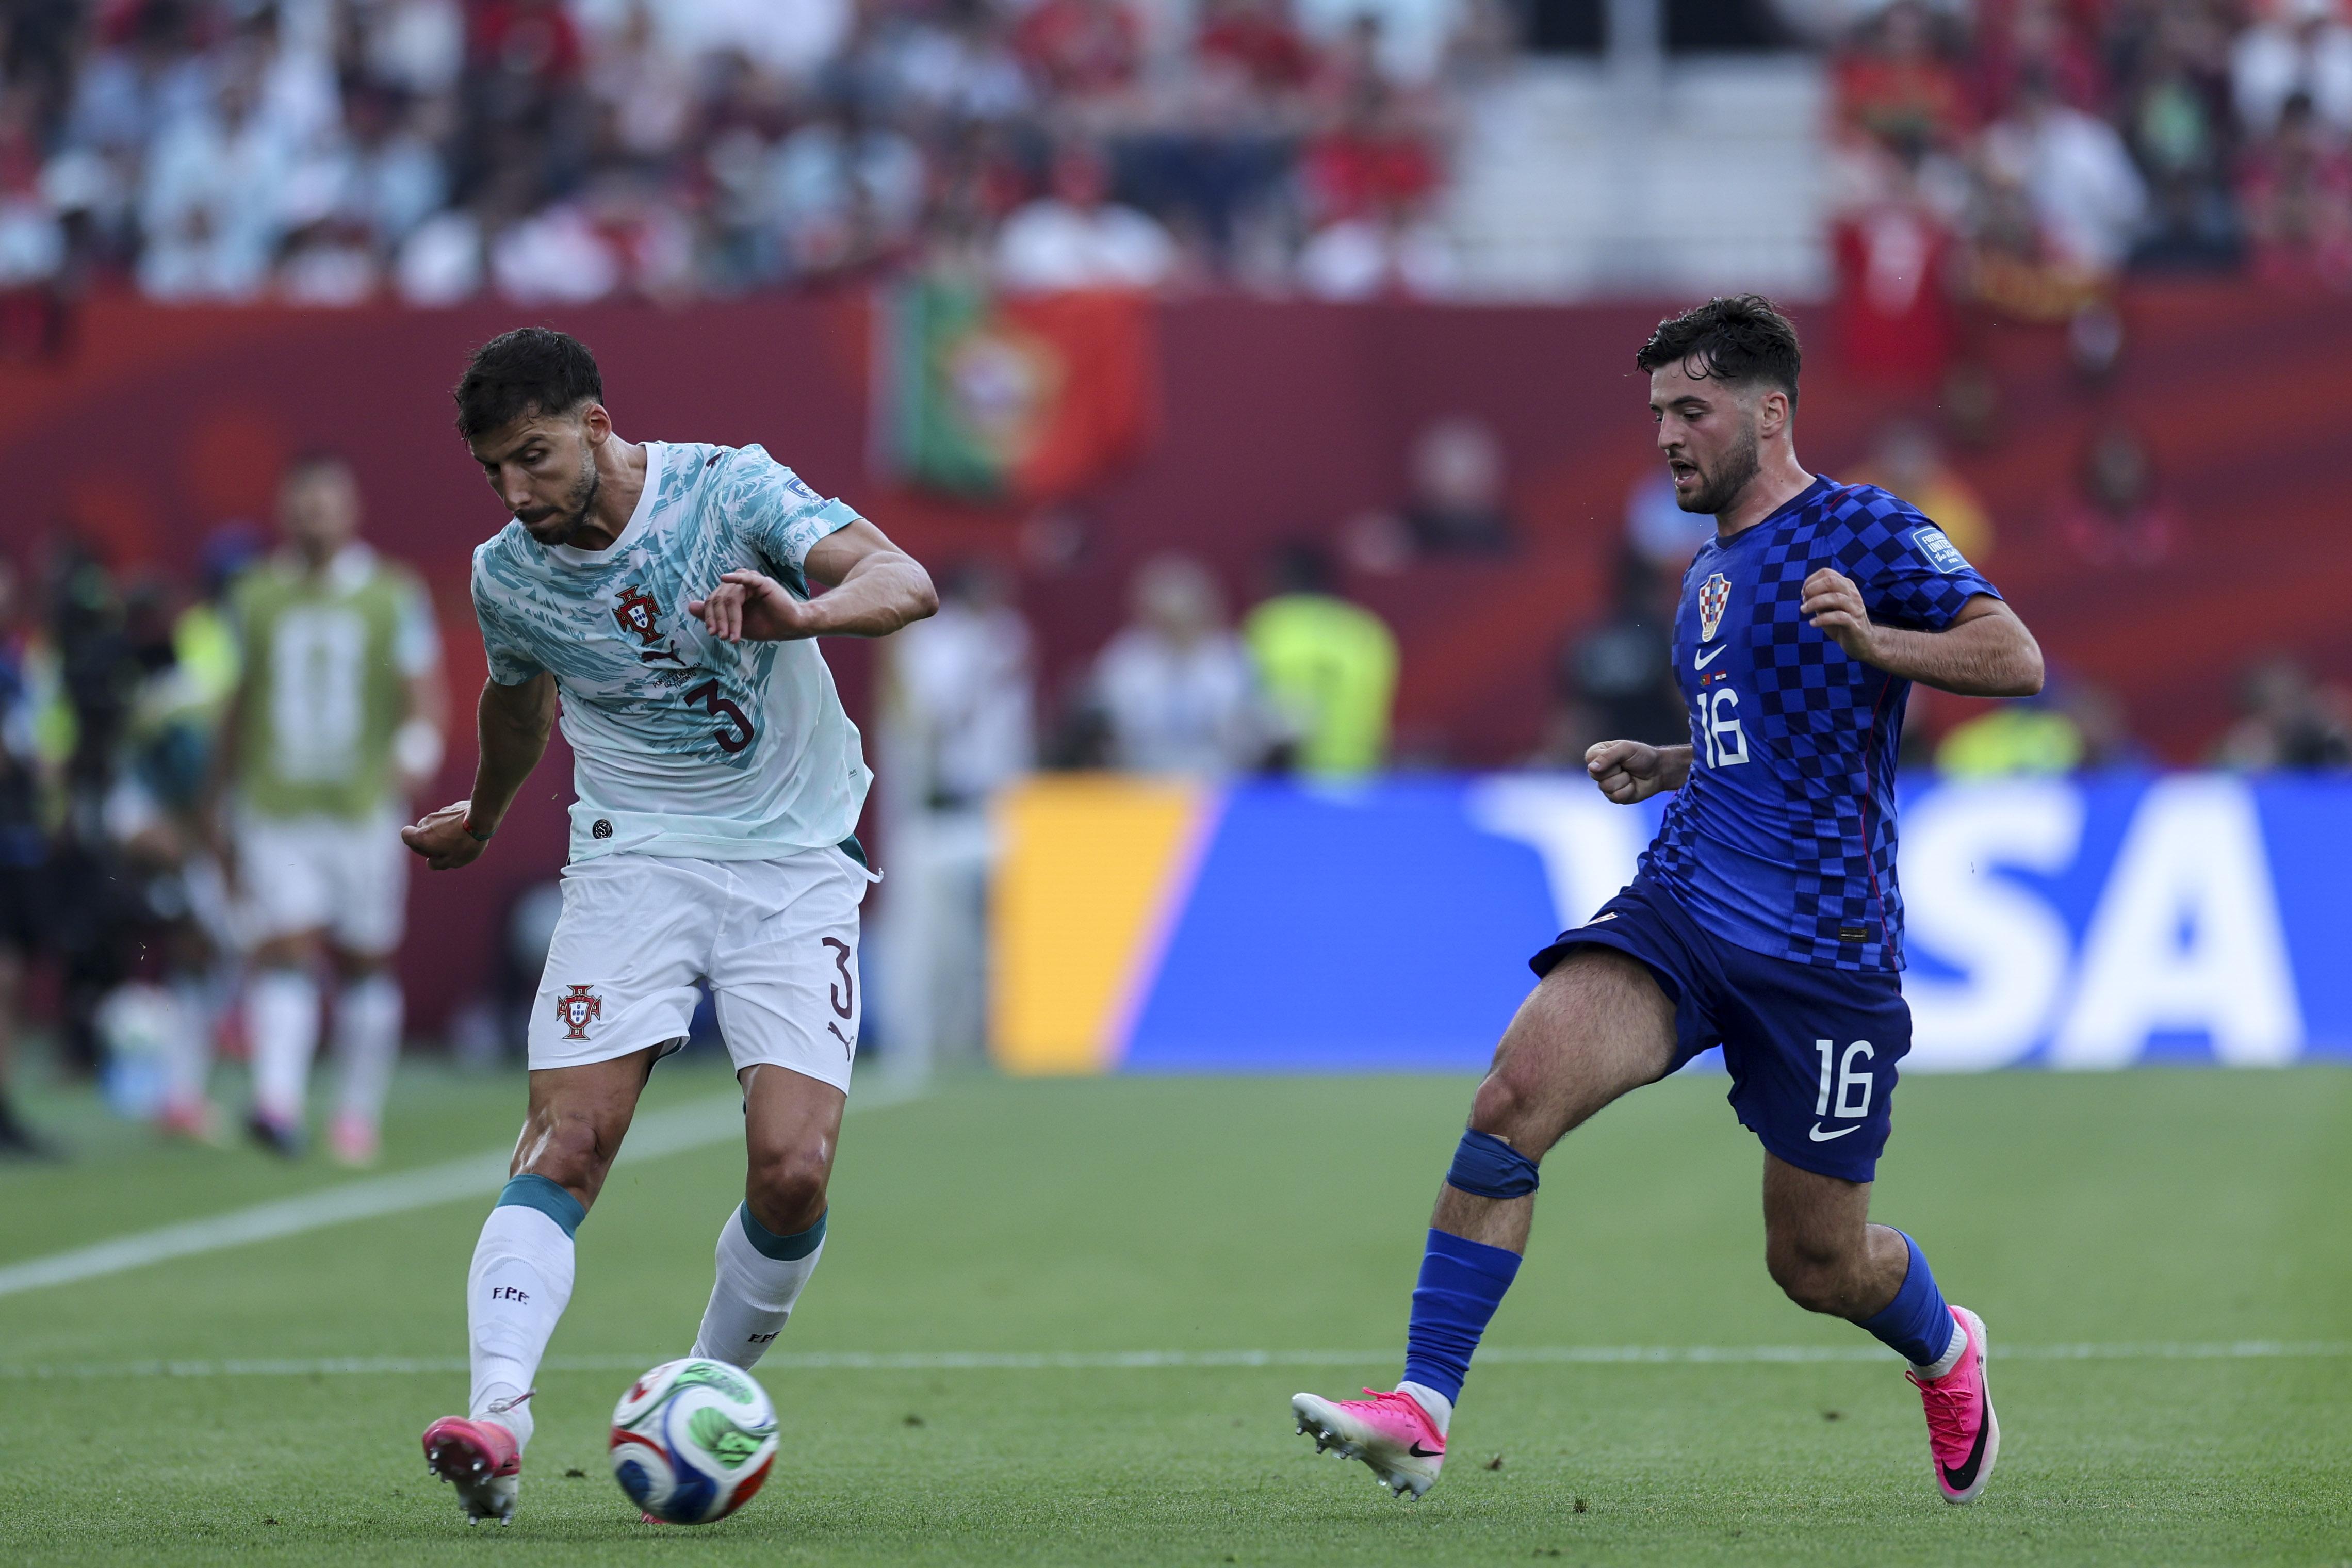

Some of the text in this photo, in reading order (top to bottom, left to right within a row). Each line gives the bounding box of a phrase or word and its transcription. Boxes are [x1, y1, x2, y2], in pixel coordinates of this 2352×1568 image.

[674, 671, 697, 689] TORONTO
[683, 677, 754, 753] 3
[1697, 688, 1750, 769] 16
[822, 937, 853, 1020] 3
[1816, 1039, 1874, 1118] 16
